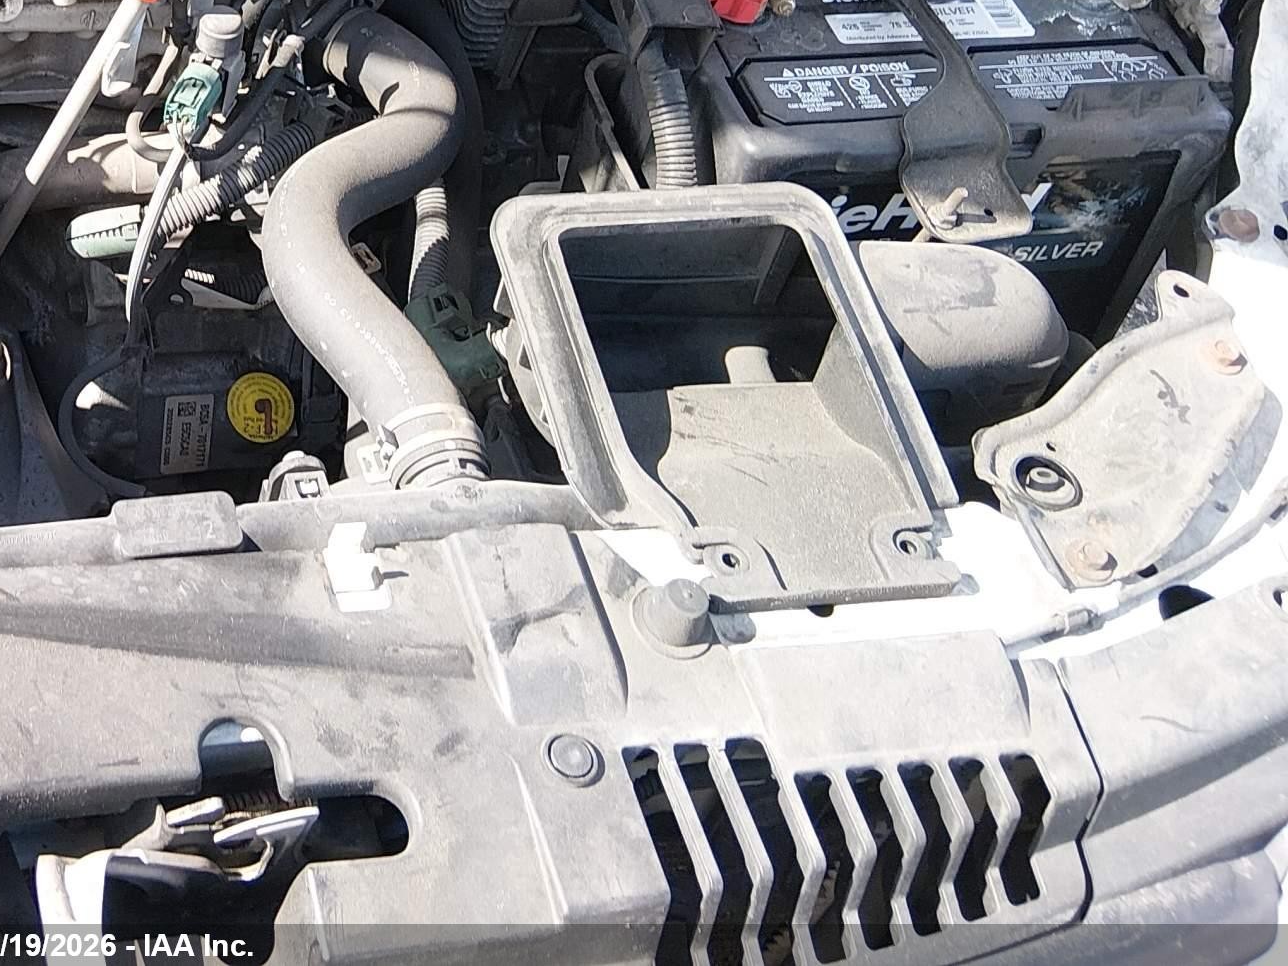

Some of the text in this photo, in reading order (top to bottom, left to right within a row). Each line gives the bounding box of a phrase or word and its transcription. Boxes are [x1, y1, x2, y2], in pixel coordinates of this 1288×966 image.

[793, 65, 849, 78] DANGER
[859, 61, 910, 74] POISON
[1016, 240, 1104, 262] SILVER
